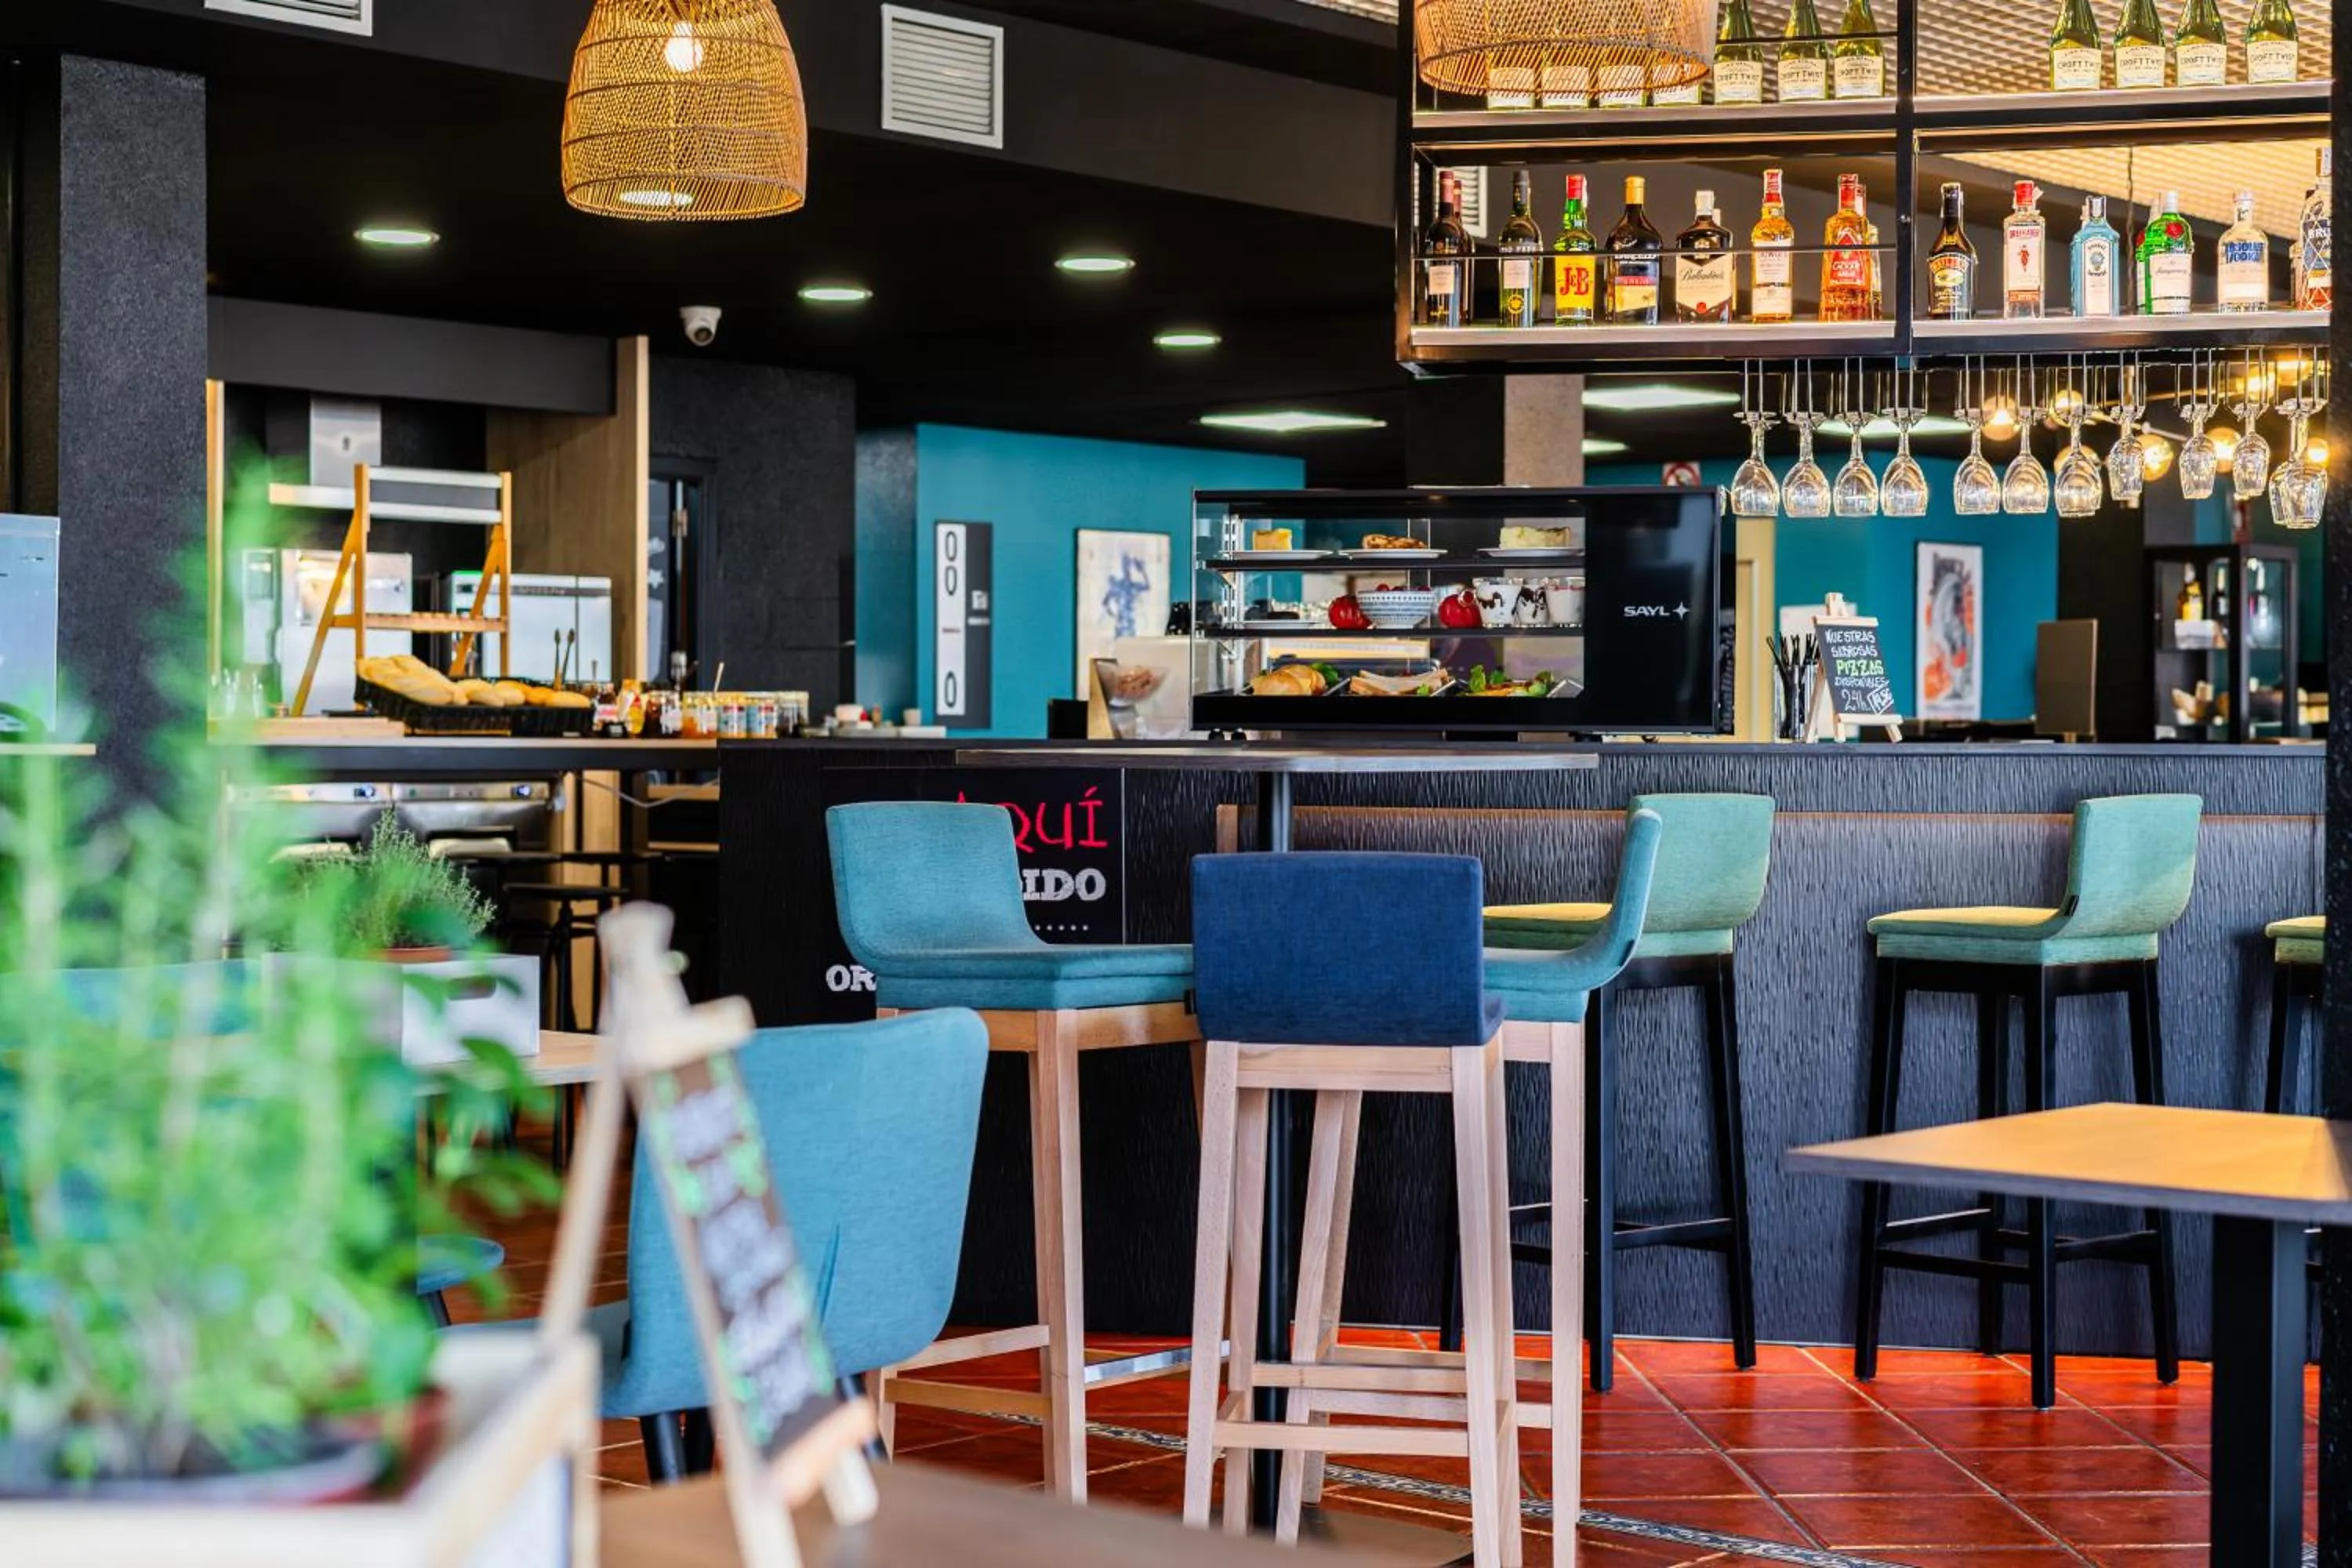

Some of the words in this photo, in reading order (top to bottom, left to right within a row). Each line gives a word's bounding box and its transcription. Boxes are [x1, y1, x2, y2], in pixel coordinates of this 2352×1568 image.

[1623, 605, 1671, 617] SAYL
[1824, 629, 1876, 644] NUESTRAS
[1835, 659, 1884, 676] PIZZAS
[1019, 868, 1107, 902] IDO
